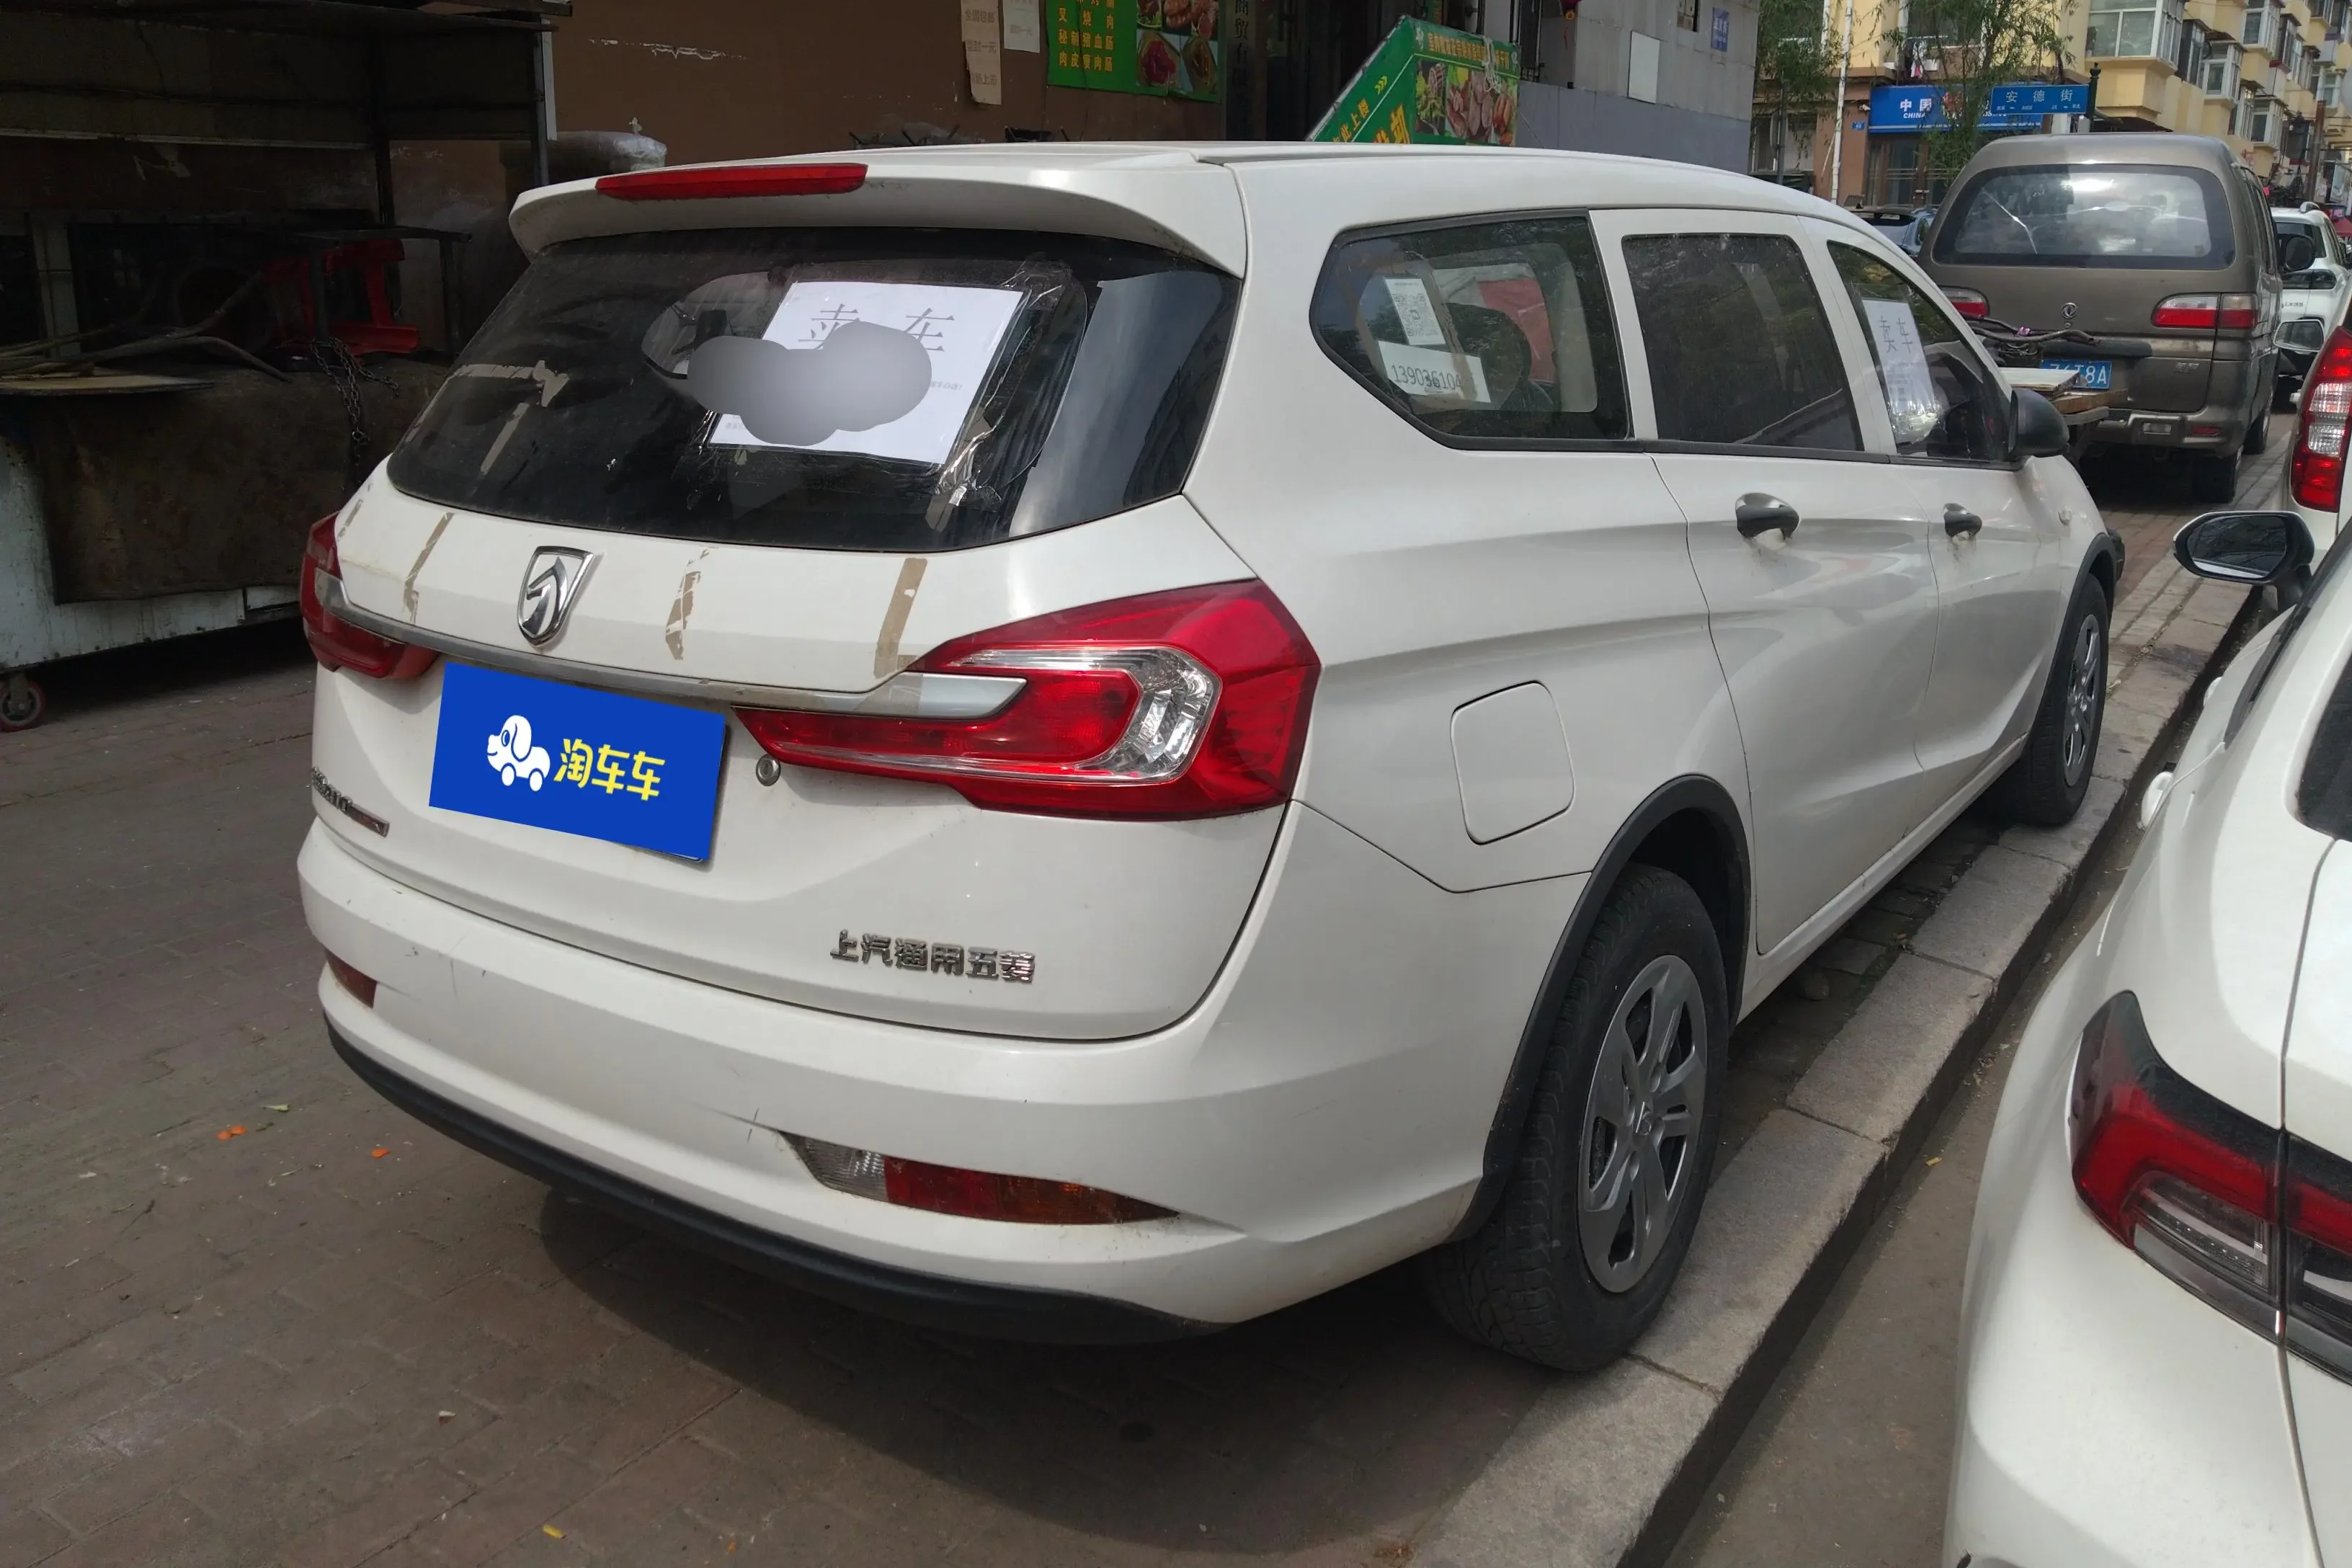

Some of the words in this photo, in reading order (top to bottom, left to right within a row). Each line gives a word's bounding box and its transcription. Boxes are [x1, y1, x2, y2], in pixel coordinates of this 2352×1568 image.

[2005, 89, 2073, 103] 安德街
[1899, 98, 1932, 112] 中国
[830, 929, 1035, 985] 上汽通用五菱
